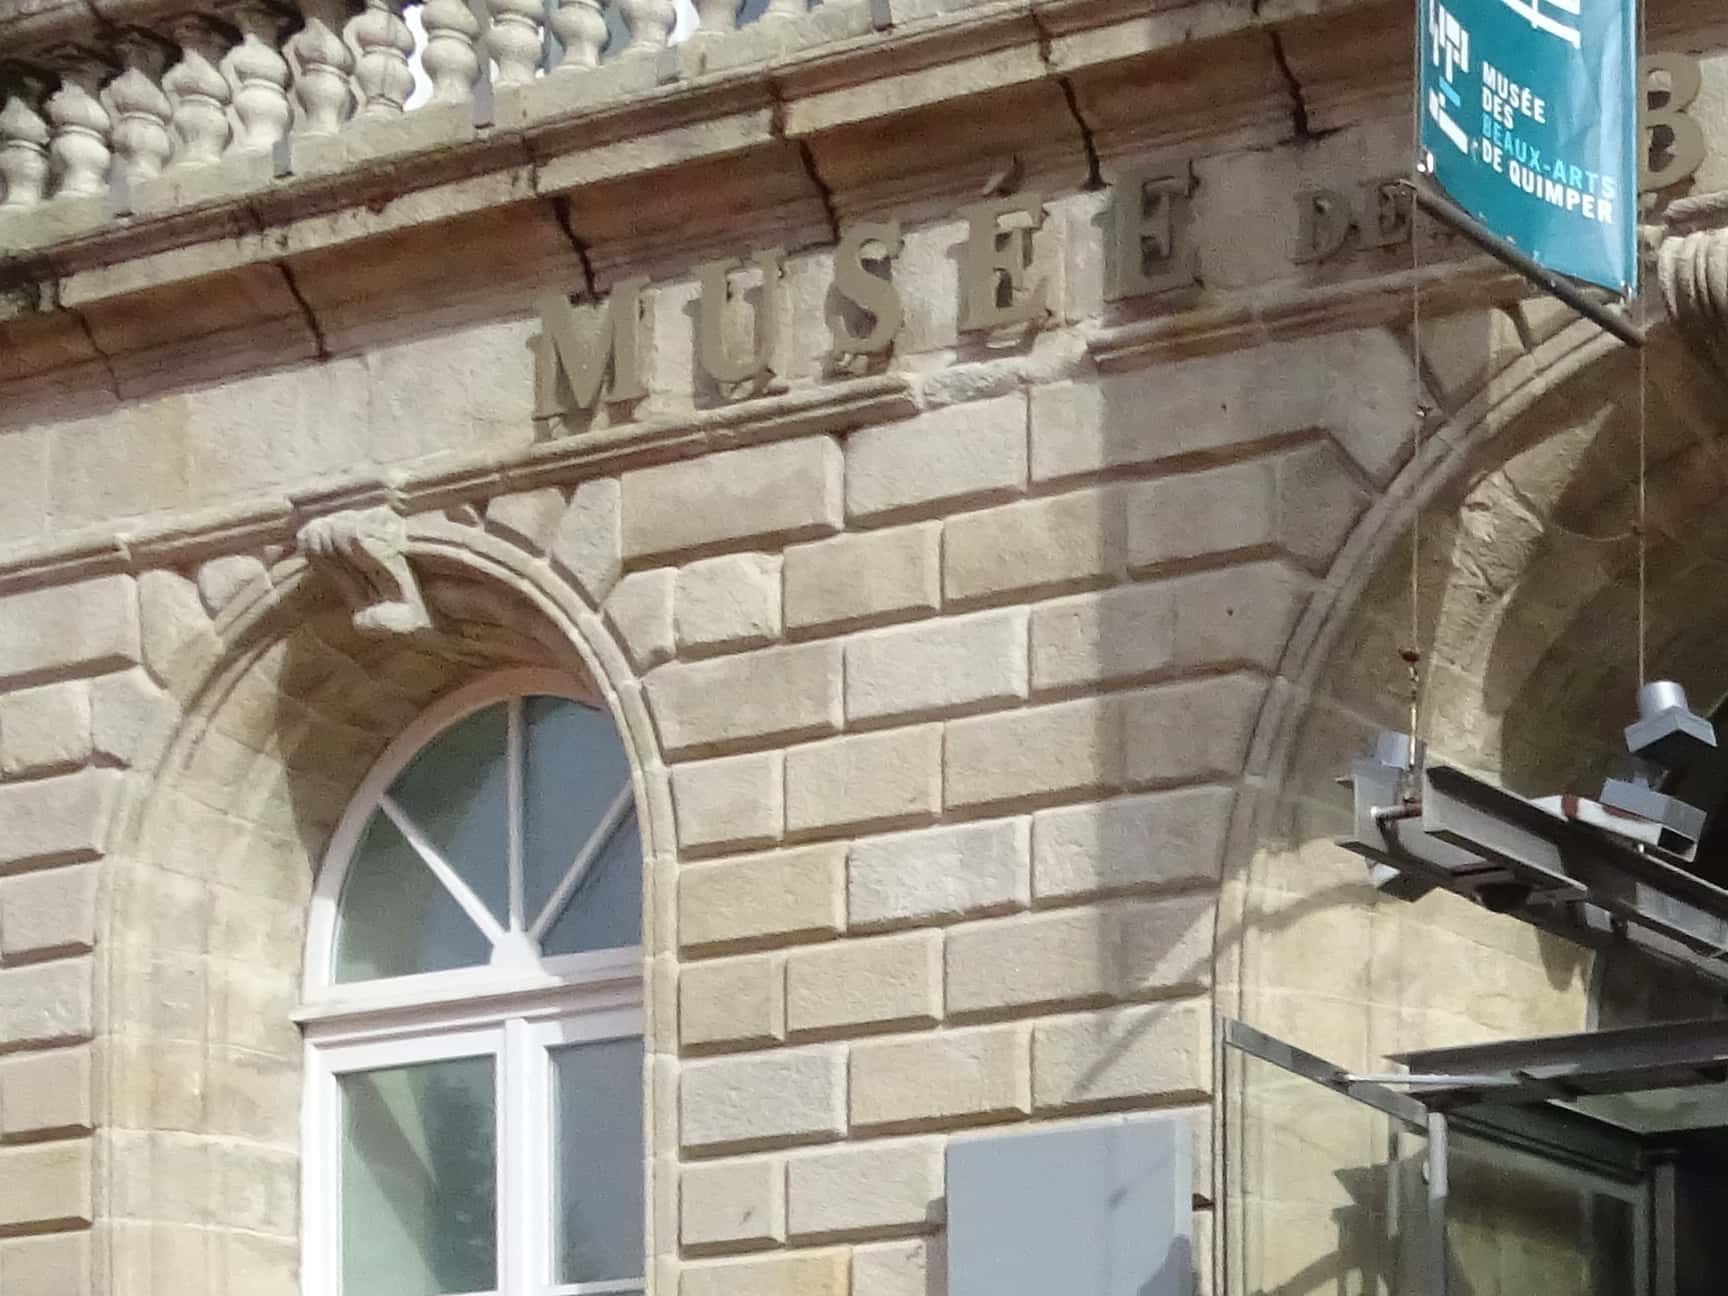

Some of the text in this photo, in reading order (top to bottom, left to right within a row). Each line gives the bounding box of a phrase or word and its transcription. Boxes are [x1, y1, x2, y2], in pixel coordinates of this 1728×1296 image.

[1482, 61, 1546, 125] MUSÉE
[1482, 86, 1514, 129] DES
[1482, 114, 1617, 200] BEAUX-ARTS
[1482, 137, 1614, 224] DE QUIMPER
[533, 153, 1197, 416] MUSÉE
